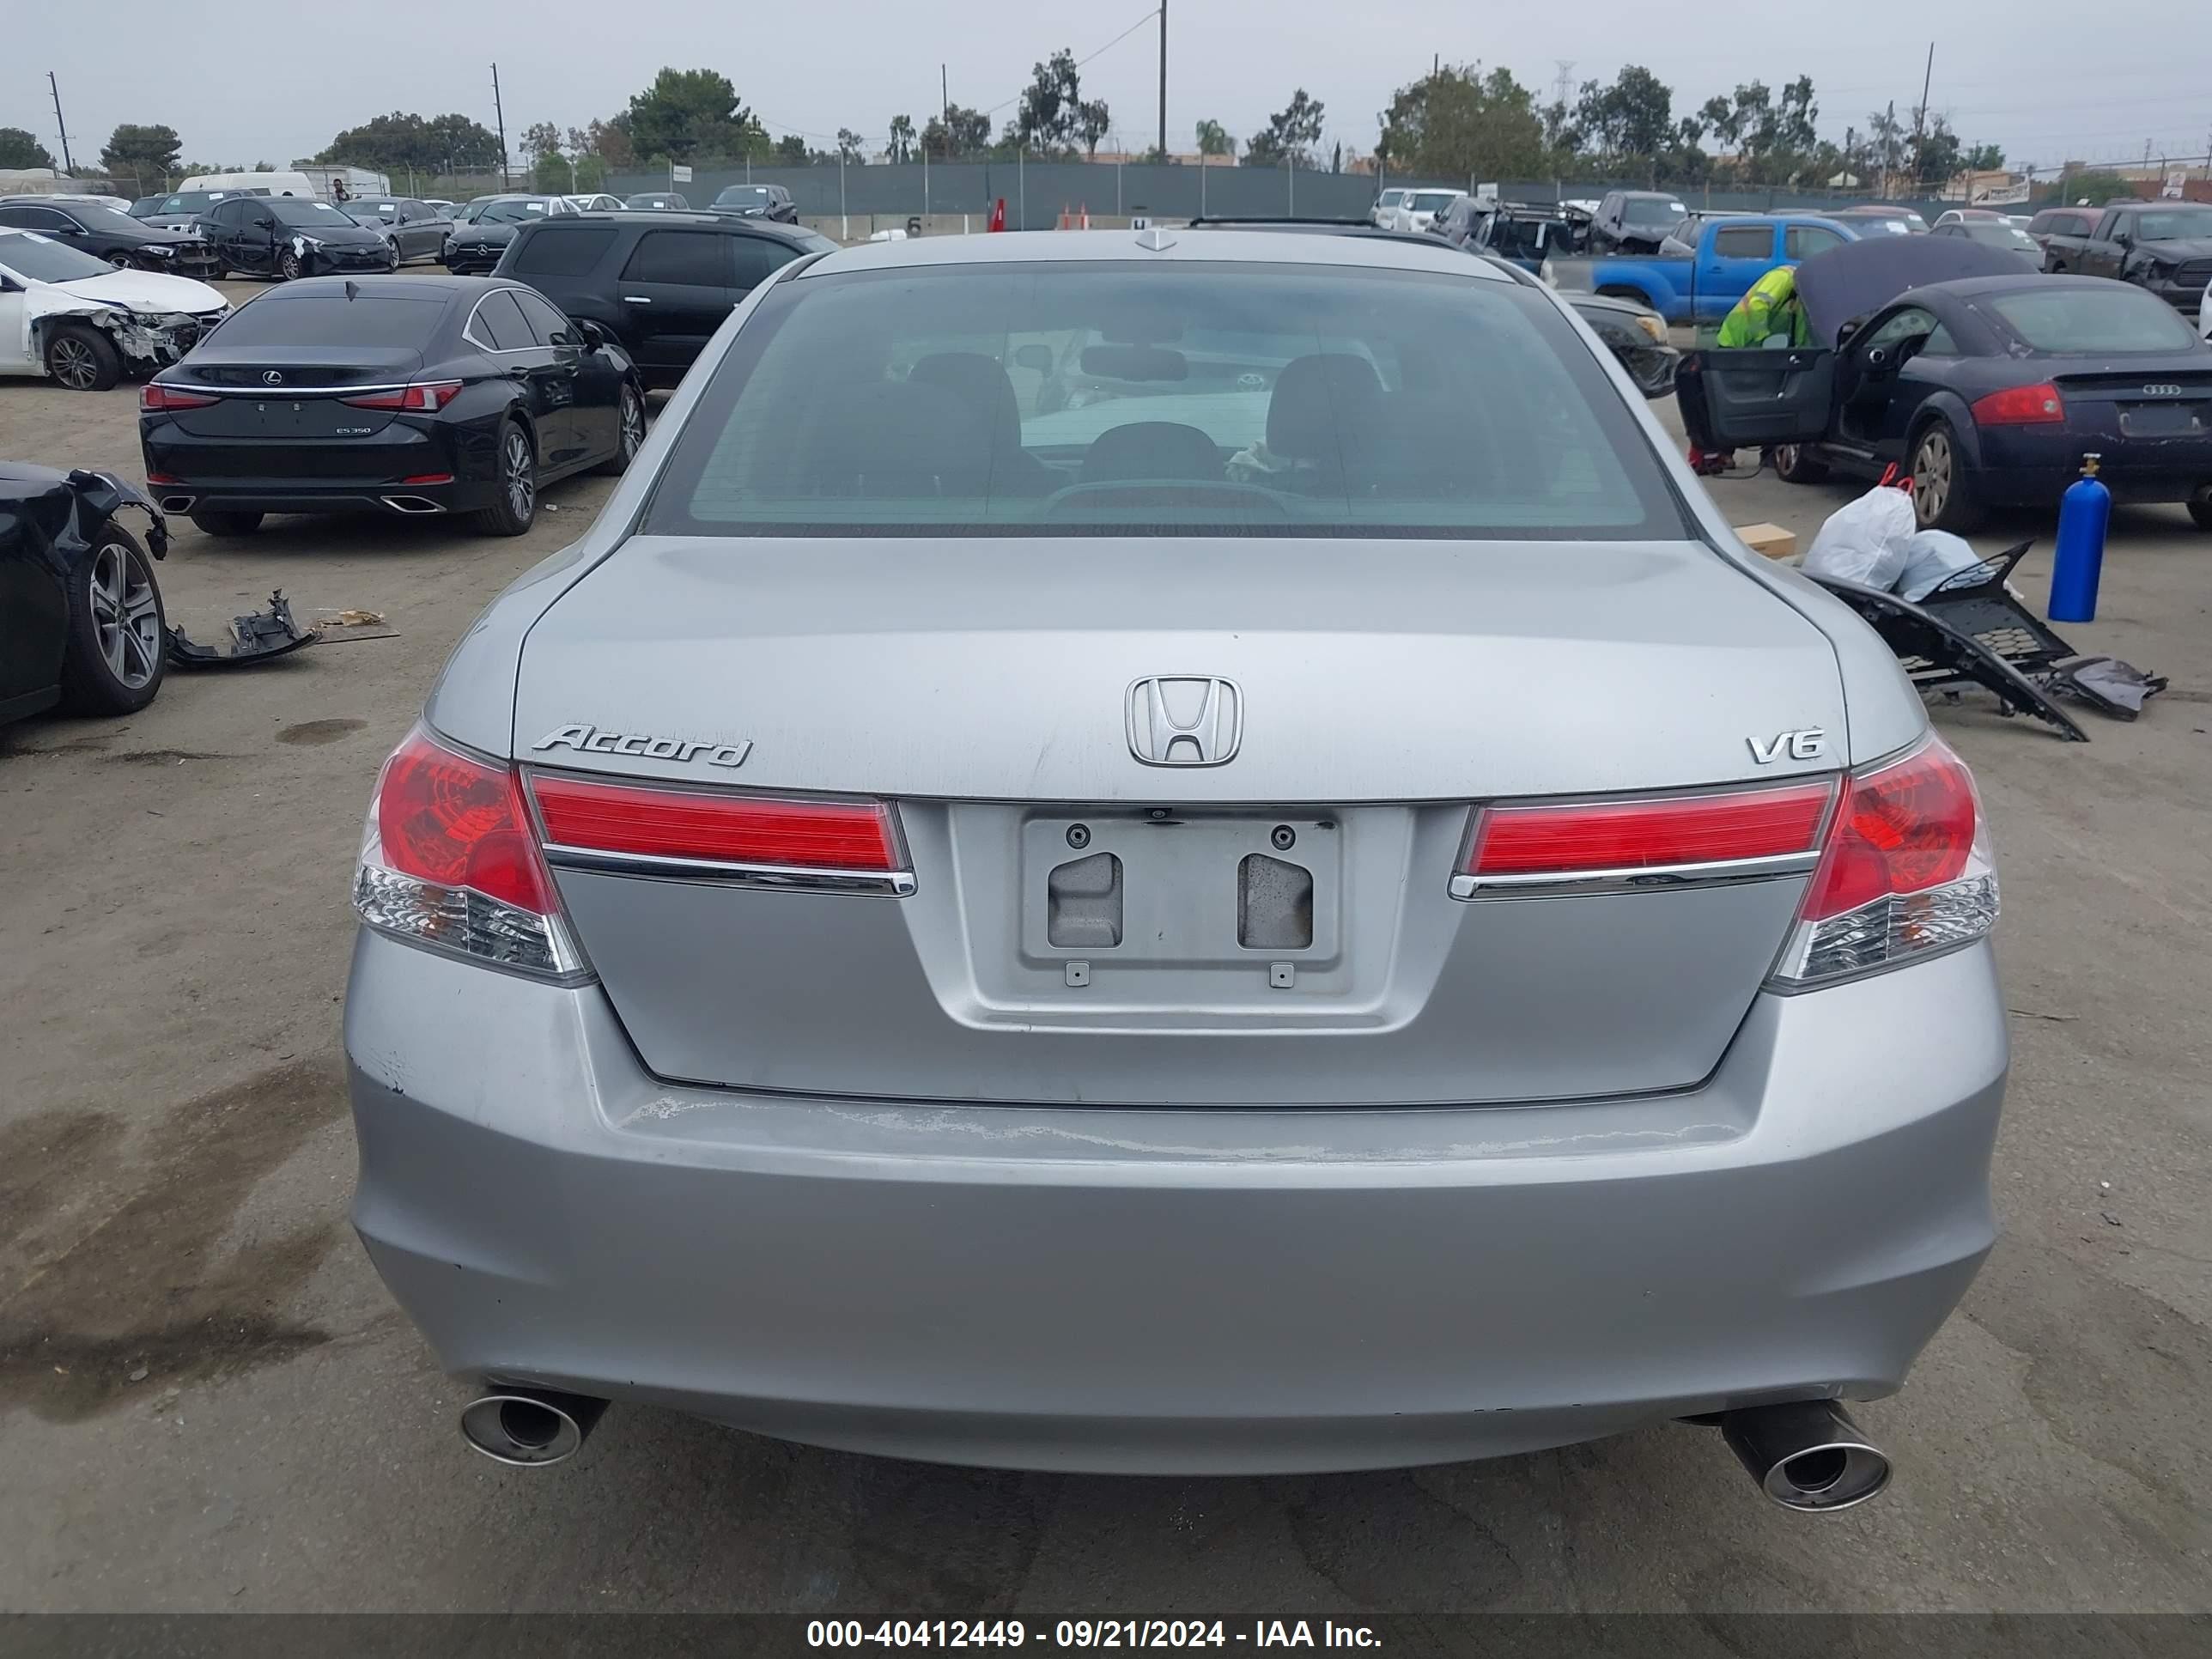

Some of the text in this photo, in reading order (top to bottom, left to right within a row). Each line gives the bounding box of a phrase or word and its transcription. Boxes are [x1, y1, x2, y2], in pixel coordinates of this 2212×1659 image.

[907, 216, 921, 239] 6
[531, 722, 754, 768] Accord
[1745, 729, 1826, 765] V6
